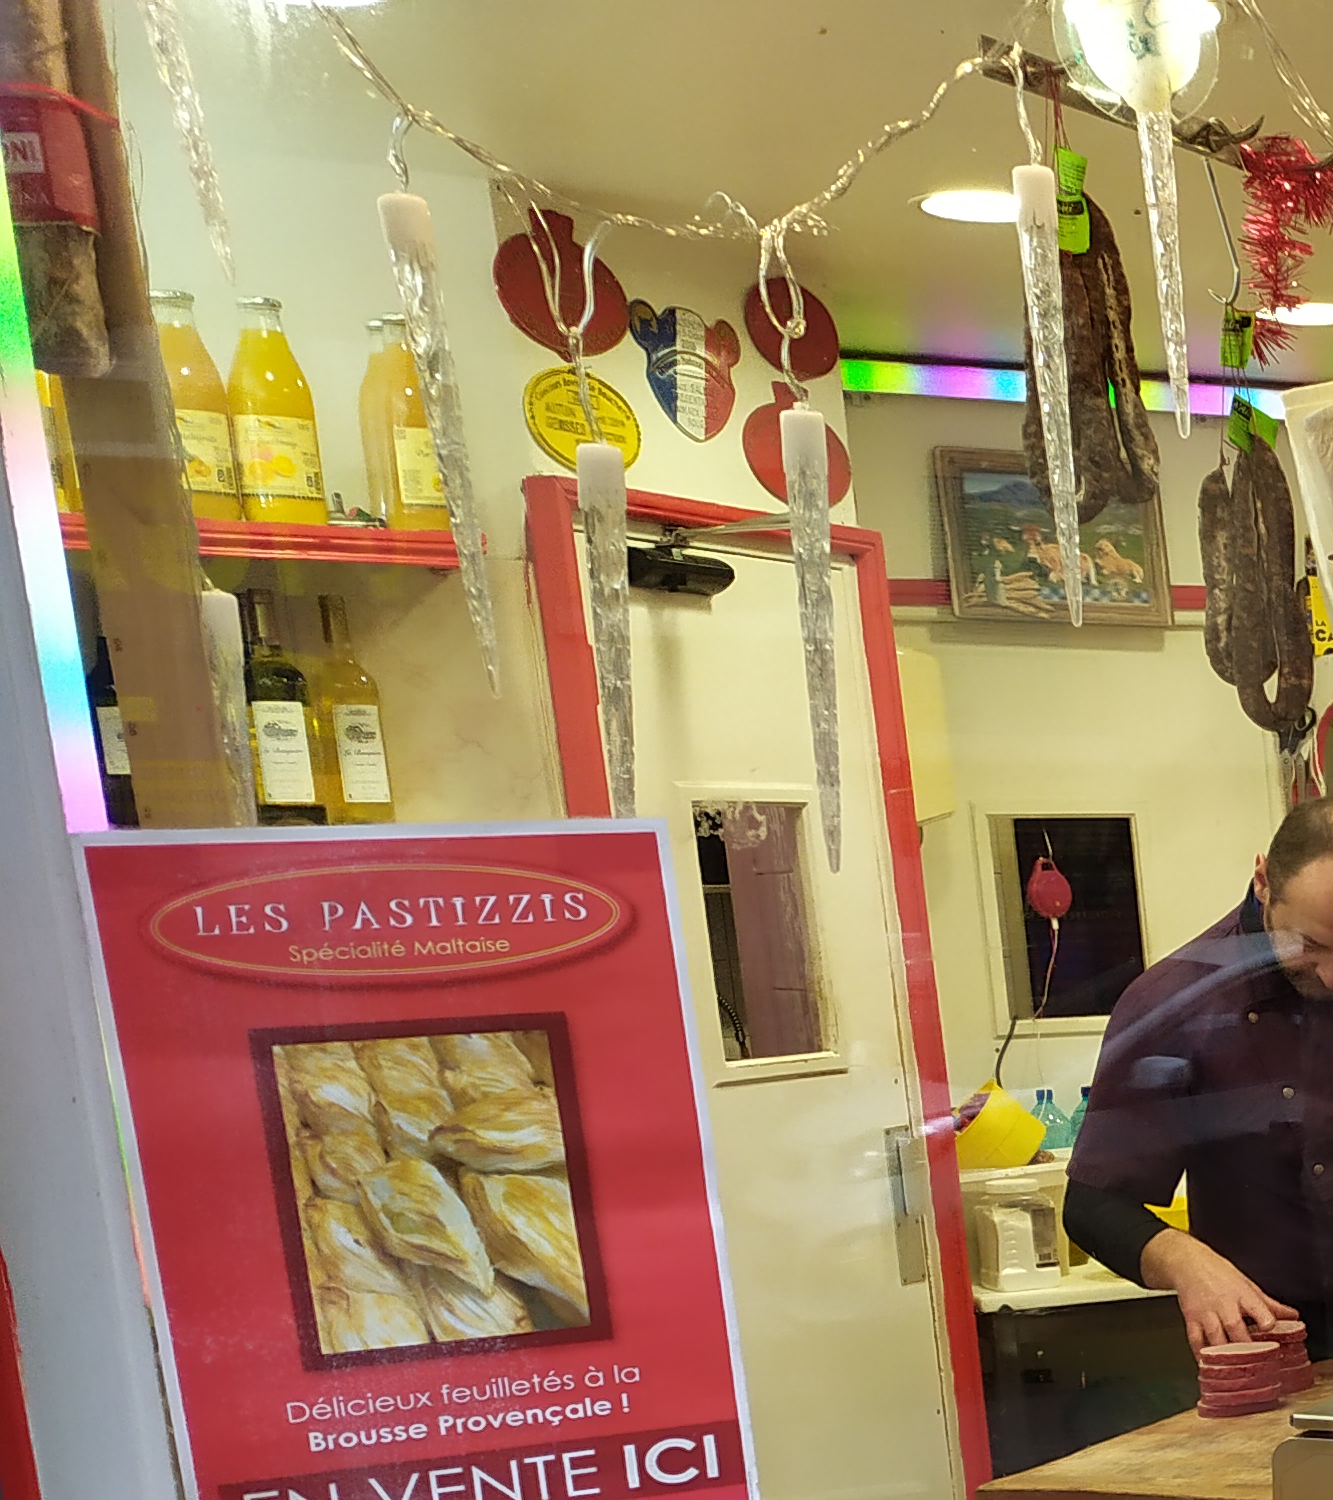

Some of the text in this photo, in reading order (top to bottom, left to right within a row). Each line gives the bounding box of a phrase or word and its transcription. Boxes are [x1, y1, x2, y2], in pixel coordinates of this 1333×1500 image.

[193, 891, 590, 938] LES PASTIZZIS
[289, 934, 511, 965] Spécialité Maltaise
[286, 1361, 641, 1425] Délicieux feuilletés à la
[307, 1419, 429, 1453] Brousse
[438, 1397, 612, 1438] Provençale
[622, 1433, 721, 1490] ICI
